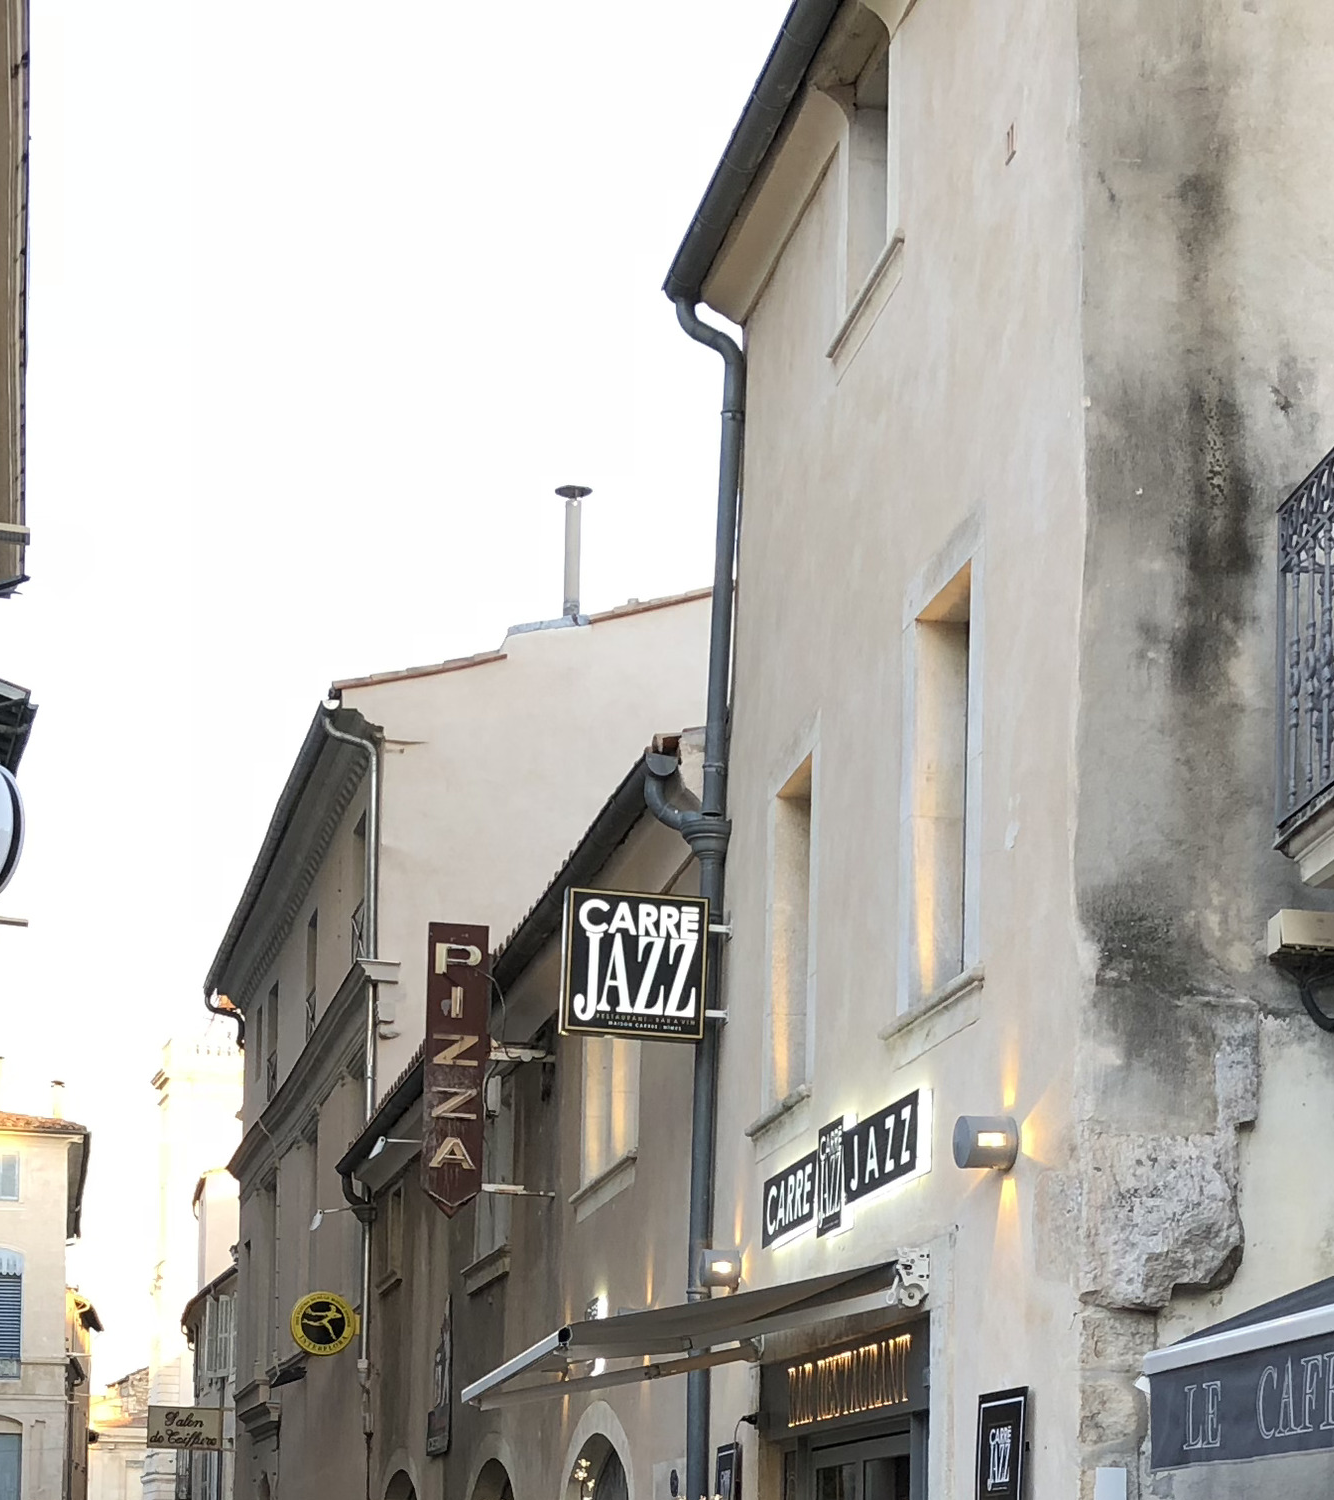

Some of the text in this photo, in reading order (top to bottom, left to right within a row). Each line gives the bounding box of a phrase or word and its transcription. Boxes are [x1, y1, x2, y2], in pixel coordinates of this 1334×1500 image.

[573, 931, 698, 1021] JAZZ
[429, 943, 482, 1170] PIZZA
[850, 1104, 912, 1192] JAZZ
[818, 1151, 843, 1229] JAZZ
[150, 1429, 218, 1448] de Coiffure
[165, 1411, 204, 1428] Salon
[1183, 1380, 1222, 1451] LE
[987, 1443, 1011, 1491] JAZZ
